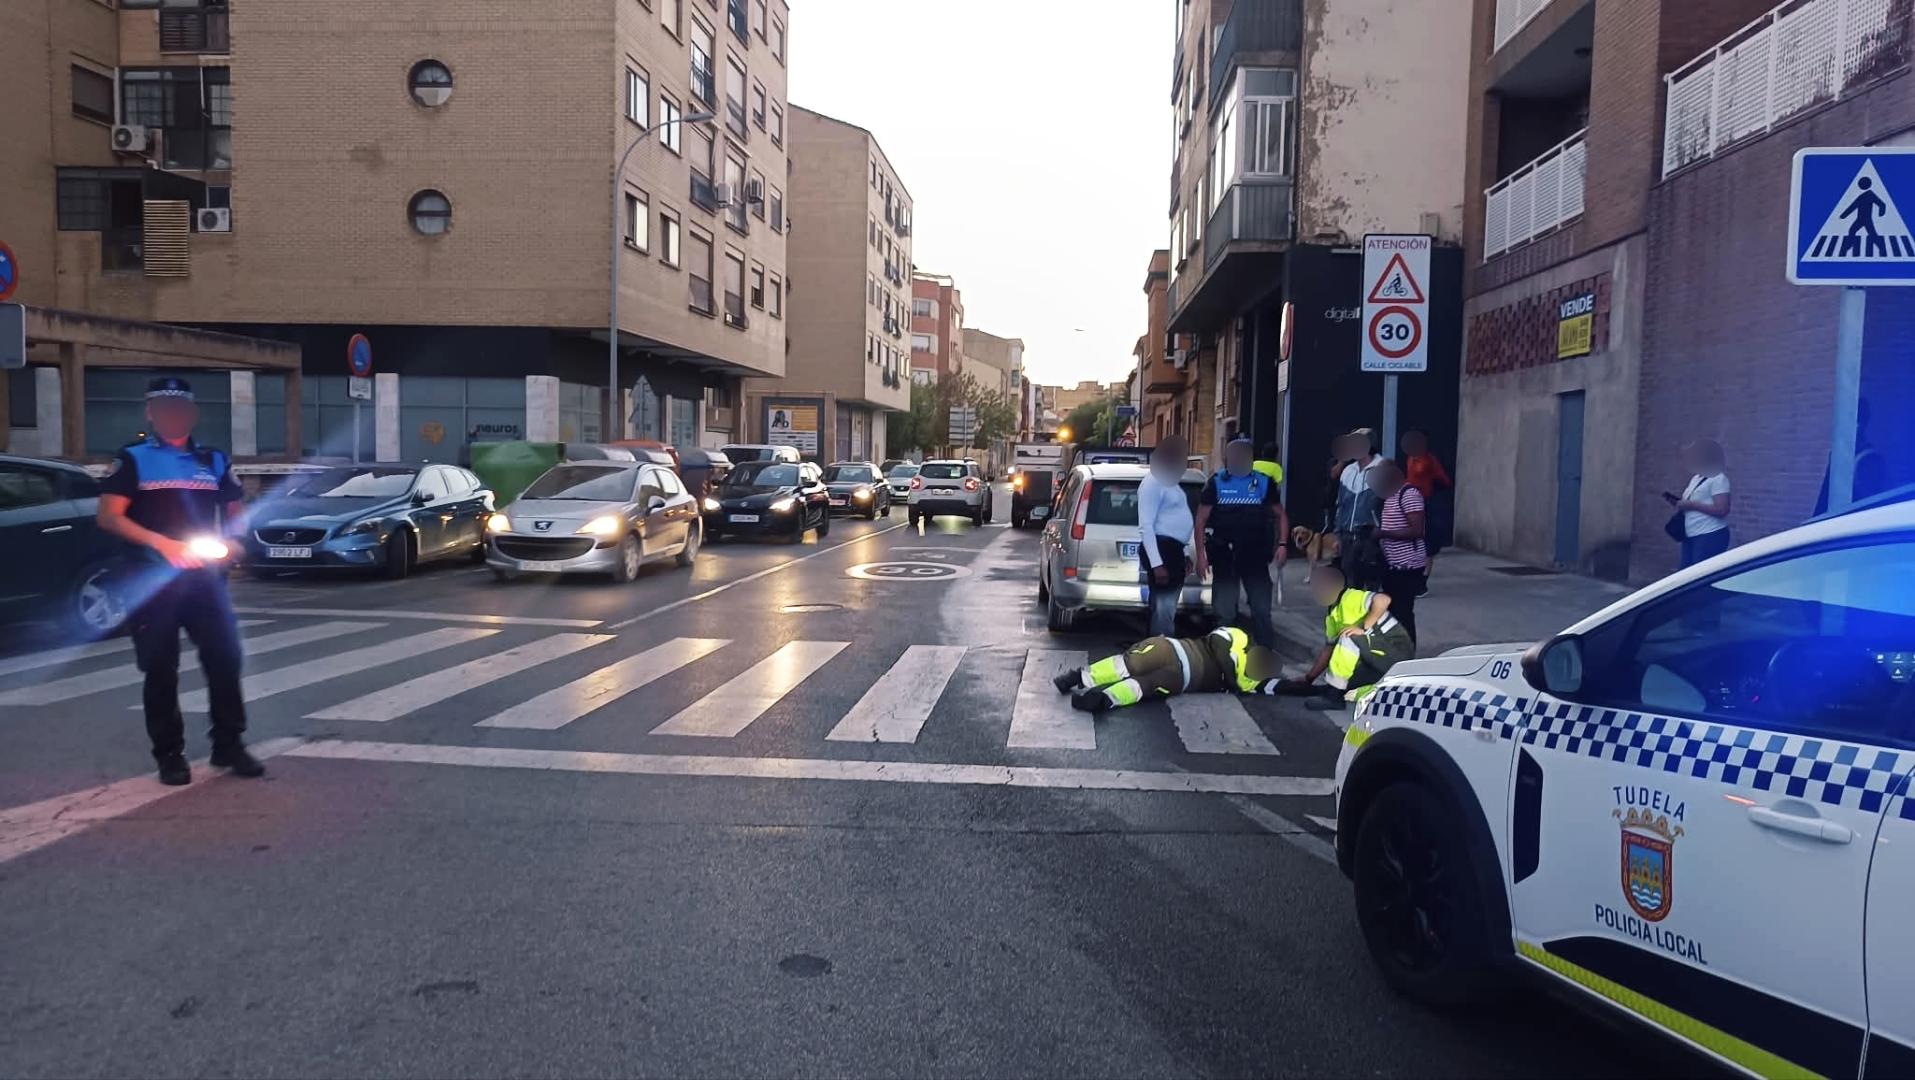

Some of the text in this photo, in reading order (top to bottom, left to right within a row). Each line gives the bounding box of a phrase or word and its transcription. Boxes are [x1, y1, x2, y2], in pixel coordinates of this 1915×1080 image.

[1368, 238, 1428, 250] ATENCIÓN
[1560, 294, 1594, 319] VENDE
[1381, 323, 1409, 340] 30
[1491, 660, 1512, 680] 06
[1613, 785, 1686, 822] TUDELA
[1595, 903, 1708, 966] POLICIA LOCAL
